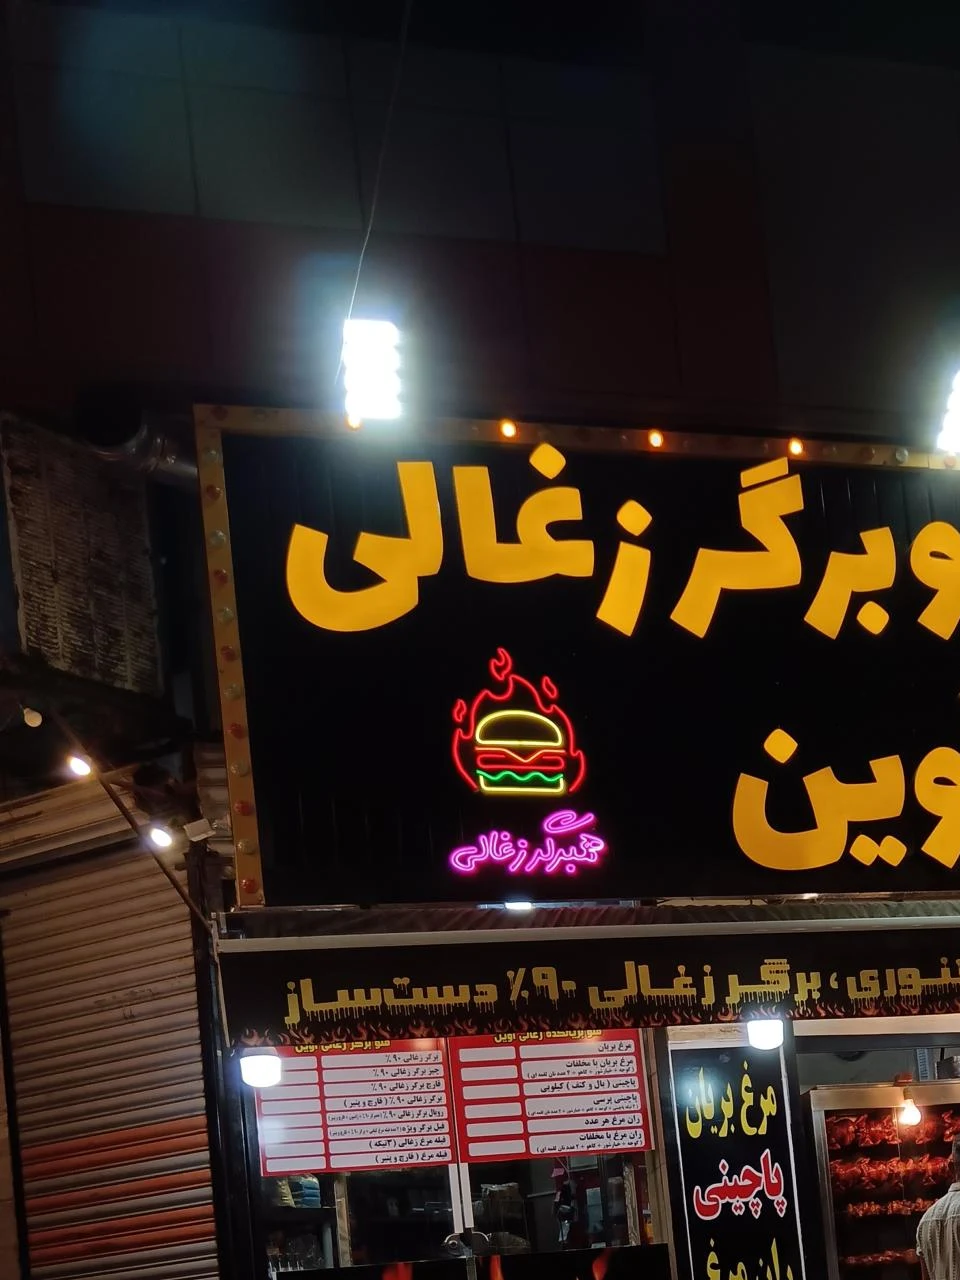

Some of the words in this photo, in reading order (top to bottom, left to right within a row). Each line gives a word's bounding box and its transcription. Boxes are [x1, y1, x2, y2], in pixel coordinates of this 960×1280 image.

[286, 442, 653, 637] زغالی
[669, 456, 897, 640] برگر
[451, 831, 529, 872] زغالی
[588, 960, 716, 1013] زغالی
[725, 958, 822, 1016] برگر
[598, 1043, 616, 1052] بریان
[618, 1041, 631, 1051] مرغ
[404, 1055, 424, 1063] زغالی
[600, 1058, 617, 1067] بریان
[620, 1057, 633, 1066] مرغ
[391, 1069, 411, 1077] زغالی
[389, 1082, 409, 1091] زغالی
[427, 1080, 441, 1089] قارچ
[613, 1078, 635, 1088] پاچینی
[407, 1097, 426, 1105] زغالی
[428, 1095, 442, 1103] برگر
[614, 1094, 637, 1103] پاچینی
[686, 1066, 735, 1140] بریان
[740, 1061, 777, 1137] مرغ
[398, 1111, 414, 1119] زغالی
[628, 1115, 640, 1124] ران
[612, 1116, 625, 1125] مرغ
[613, 1132, 627, 1140] مرغ
[629, 1131, 642, 1139] ران
[399, 1139, 417, 1147] زغالی
[692, 1148, 787, 1220] پاچینی
